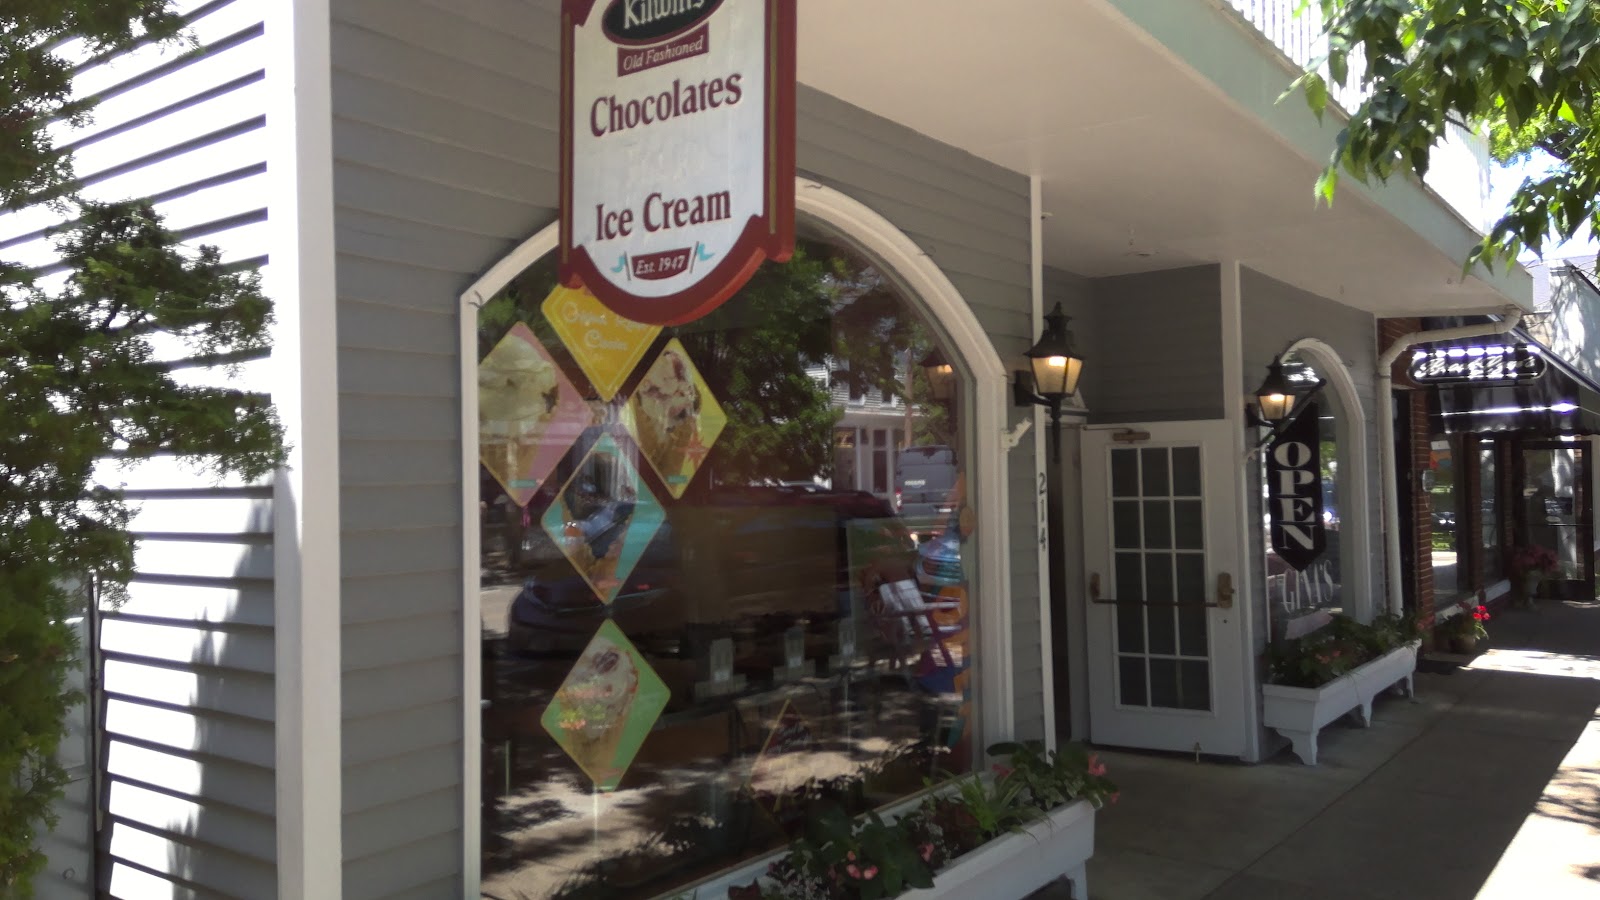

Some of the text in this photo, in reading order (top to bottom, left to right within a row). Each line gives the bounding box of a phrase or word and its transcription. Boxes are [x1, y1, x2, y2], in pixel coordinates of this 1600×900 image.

[623, 35, 704, 71] Old Fashioned
[590, 73, 743, 138] Chocolates
[596, 190, 731, 241] Ice Cream
[657, 255, 686, 273] 1947
[1038, 472, 1046, 552] 214
[1274, 441, 1318, 550] OPEN
